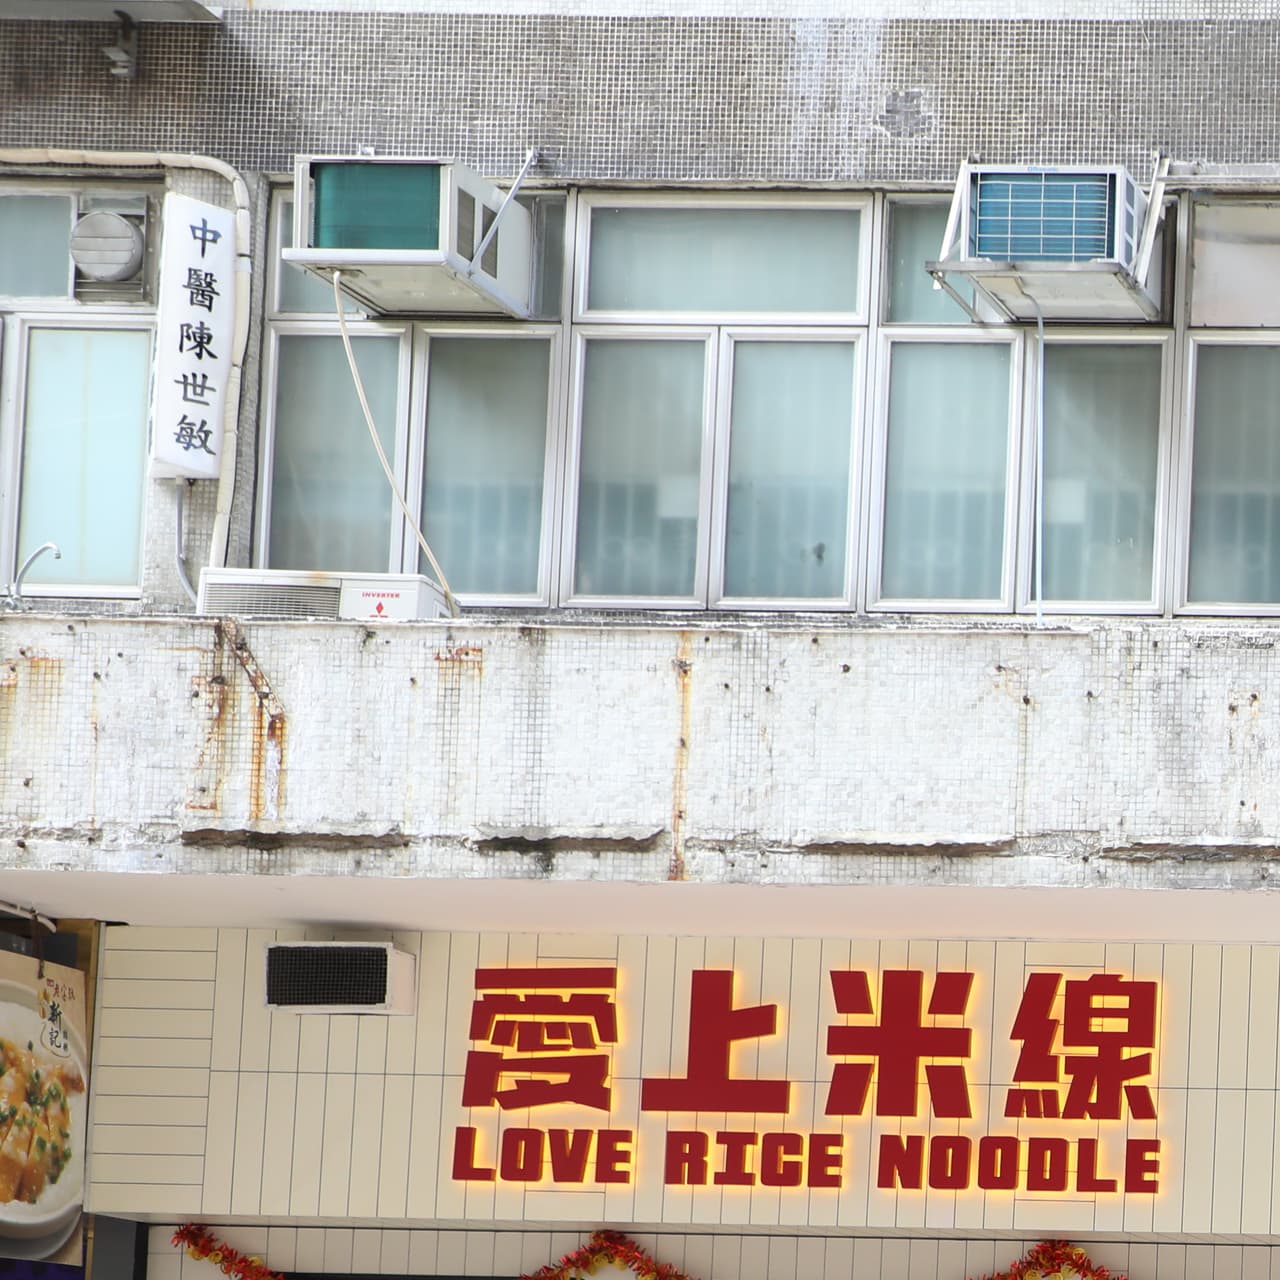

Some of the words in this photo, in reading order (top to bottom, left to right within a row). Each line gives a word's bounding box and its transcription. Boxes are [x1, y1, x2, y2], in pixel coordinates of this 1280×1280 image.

[174, 217, 222, 458] 中醫陳世敏
[462, 967, 1158, 1120] 愛上米線
[452, 1126, 633, 1185] LOVE
[664, 1130, 845, 1189] RICE
[877, 1134, 1161, 1193] NOODLE
